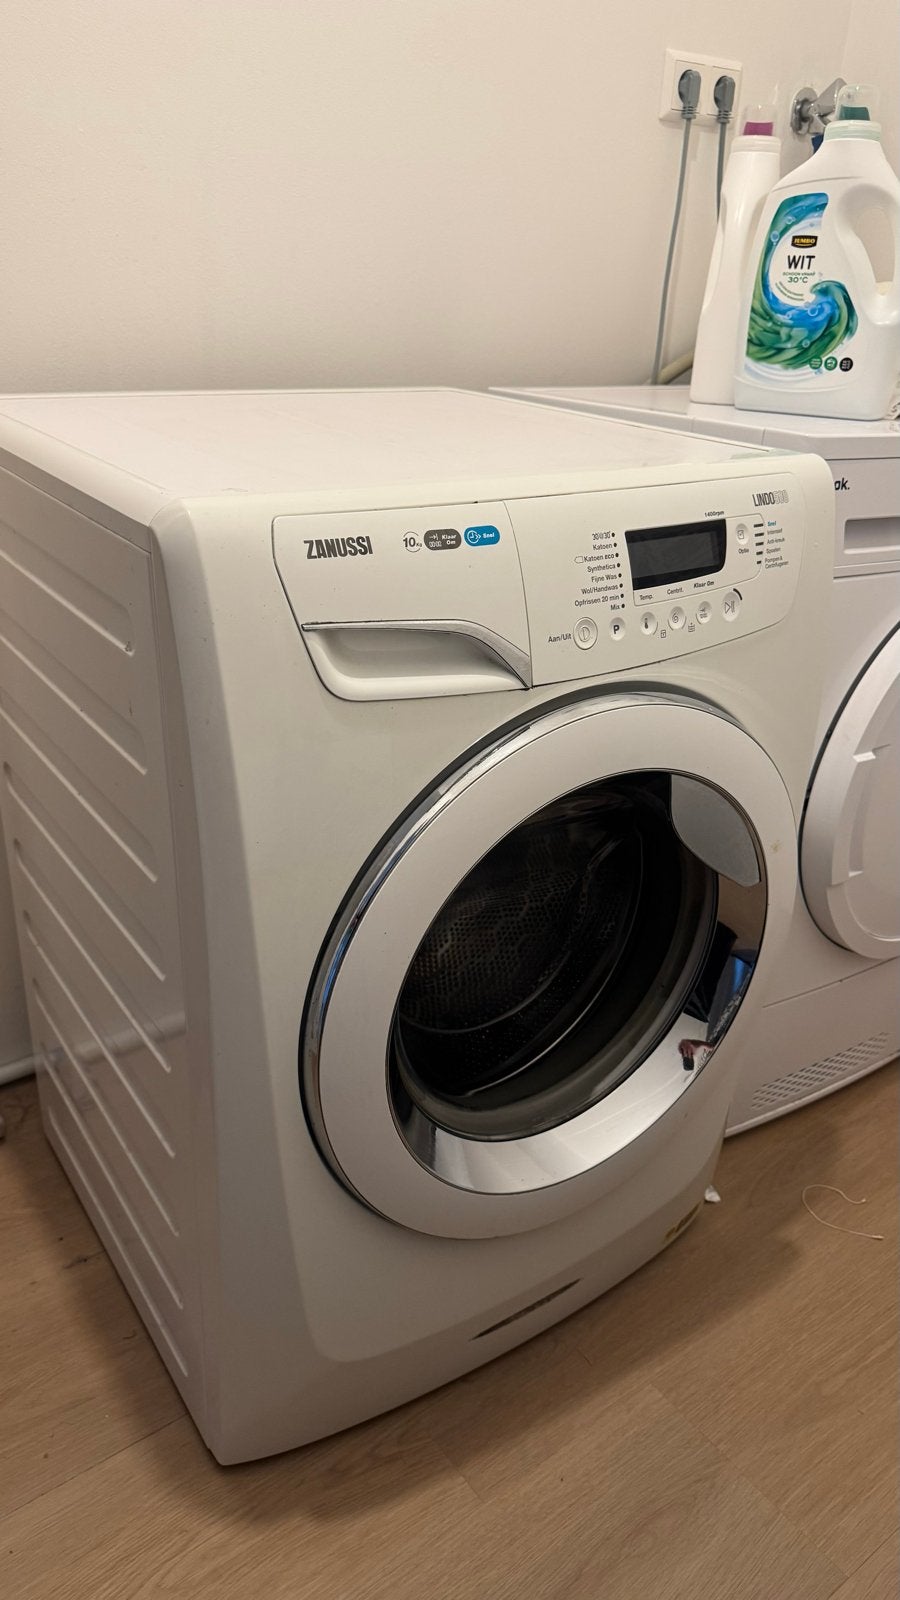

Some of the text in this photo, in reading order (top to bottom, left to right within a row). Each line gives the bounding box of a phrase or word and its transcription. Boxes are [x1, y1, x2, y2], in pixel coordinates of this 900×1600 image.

[787, 255, 816, 270] WIT
[303, 535, 374, 560] ZANUSSI
[402, 537, 416, 548] 10
[592, 543, 613, 551] Katoen
[583, 554, 604, 563] Katoen
[587, 564, 616, 573] Synthetica
[590, 576, 605, 584] Fijne
[581, 584, 619, 595] Wol/Handwas
[574, 599, 601, 607] Opfrissen
[610, 603, 620, 611] Mix
[613, 624, 620, 635] P
[547, 633, 572, 644] Aan/Uit
